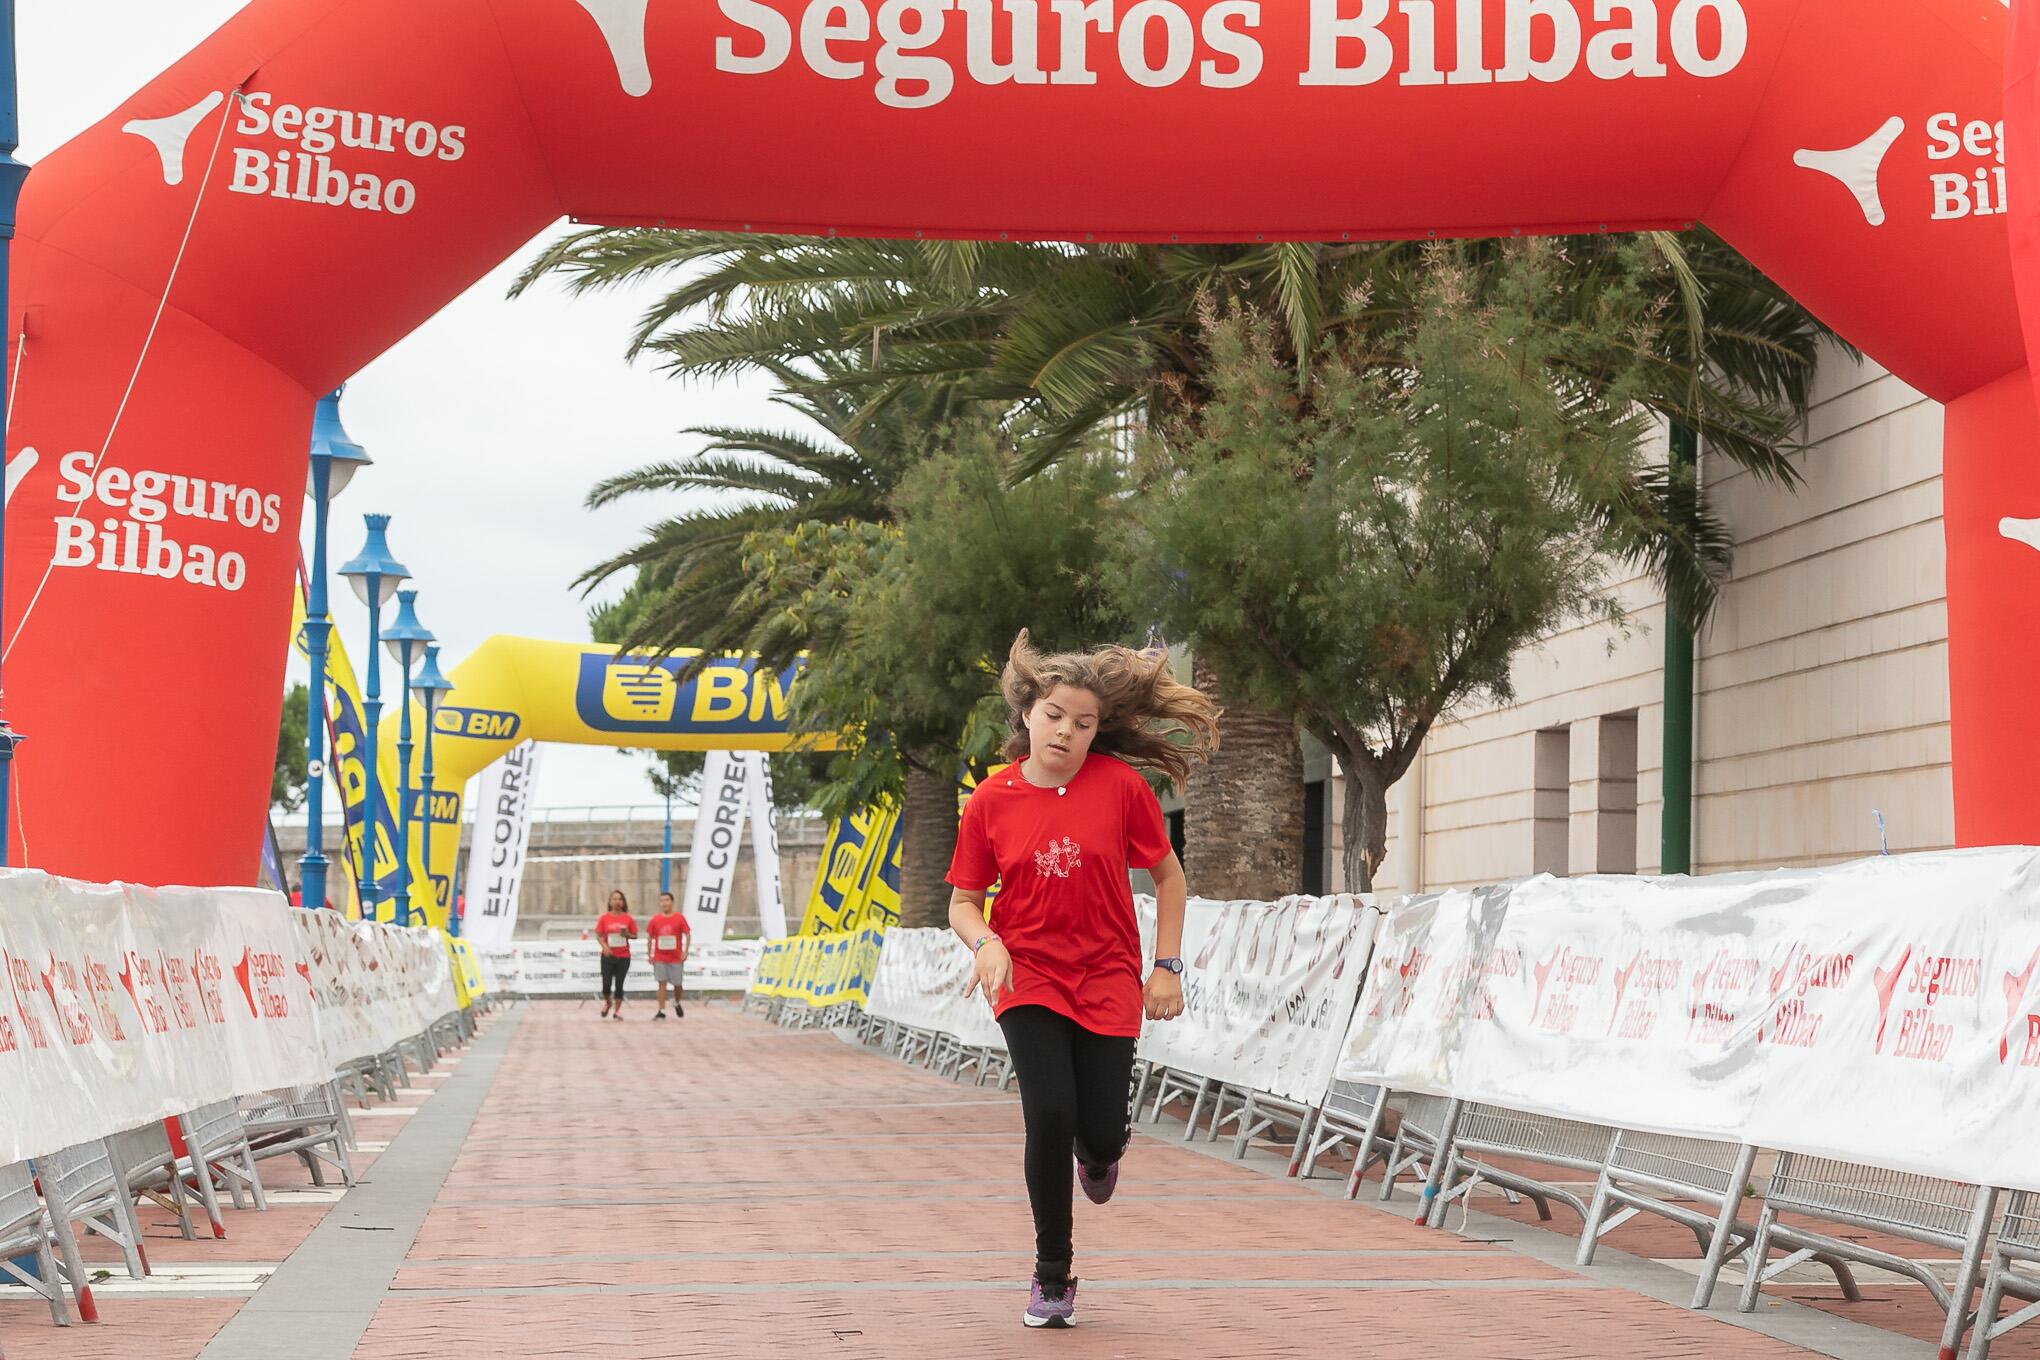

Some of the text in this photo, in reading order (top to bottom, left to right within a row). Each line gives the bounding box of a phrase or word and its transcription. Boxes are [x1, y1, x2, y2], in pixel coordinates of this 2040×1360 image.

[714, 0, 1748, 108] Seguros Bilbao
[236, 91, 466, 162] Seguros
[228, 148, 416, 215] Bilbao
[56, 450, 281, 534] Seguros
[52, 515, 246, 592] Bilbao
[466, 712, 515, 737] BM
[482, 876, 503, 916] EL
[697, 877, 724, 914] EL
[1908, 945, 1982, 1006] Seguros
[1893, 1007, 1954, 1063] Bilbao
